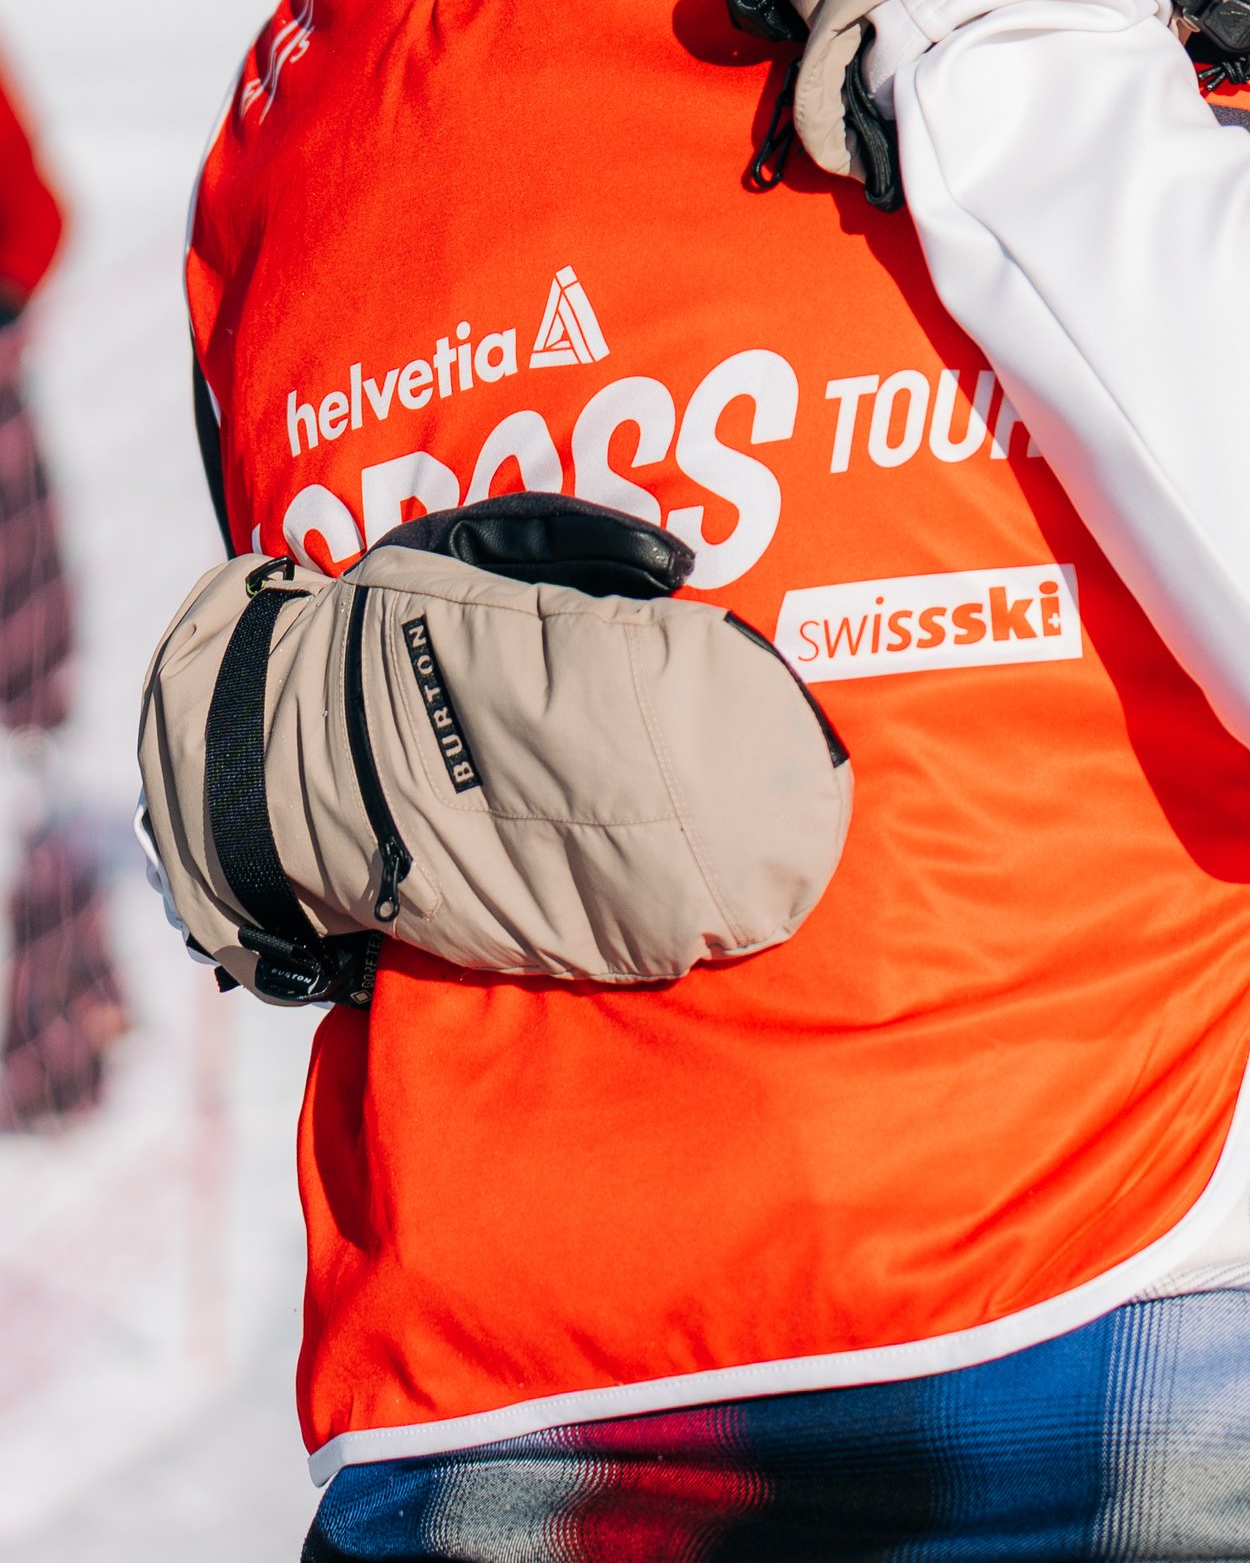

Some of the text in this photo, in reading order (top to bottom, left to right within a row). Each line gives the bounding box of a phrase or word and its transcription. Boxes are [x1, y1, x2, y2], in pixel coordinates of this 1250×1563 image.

[287, 321, 517, 457] helvetia
[798, 580, 1062, 662] swissski
[409, 625, 475, 784] BURTON
